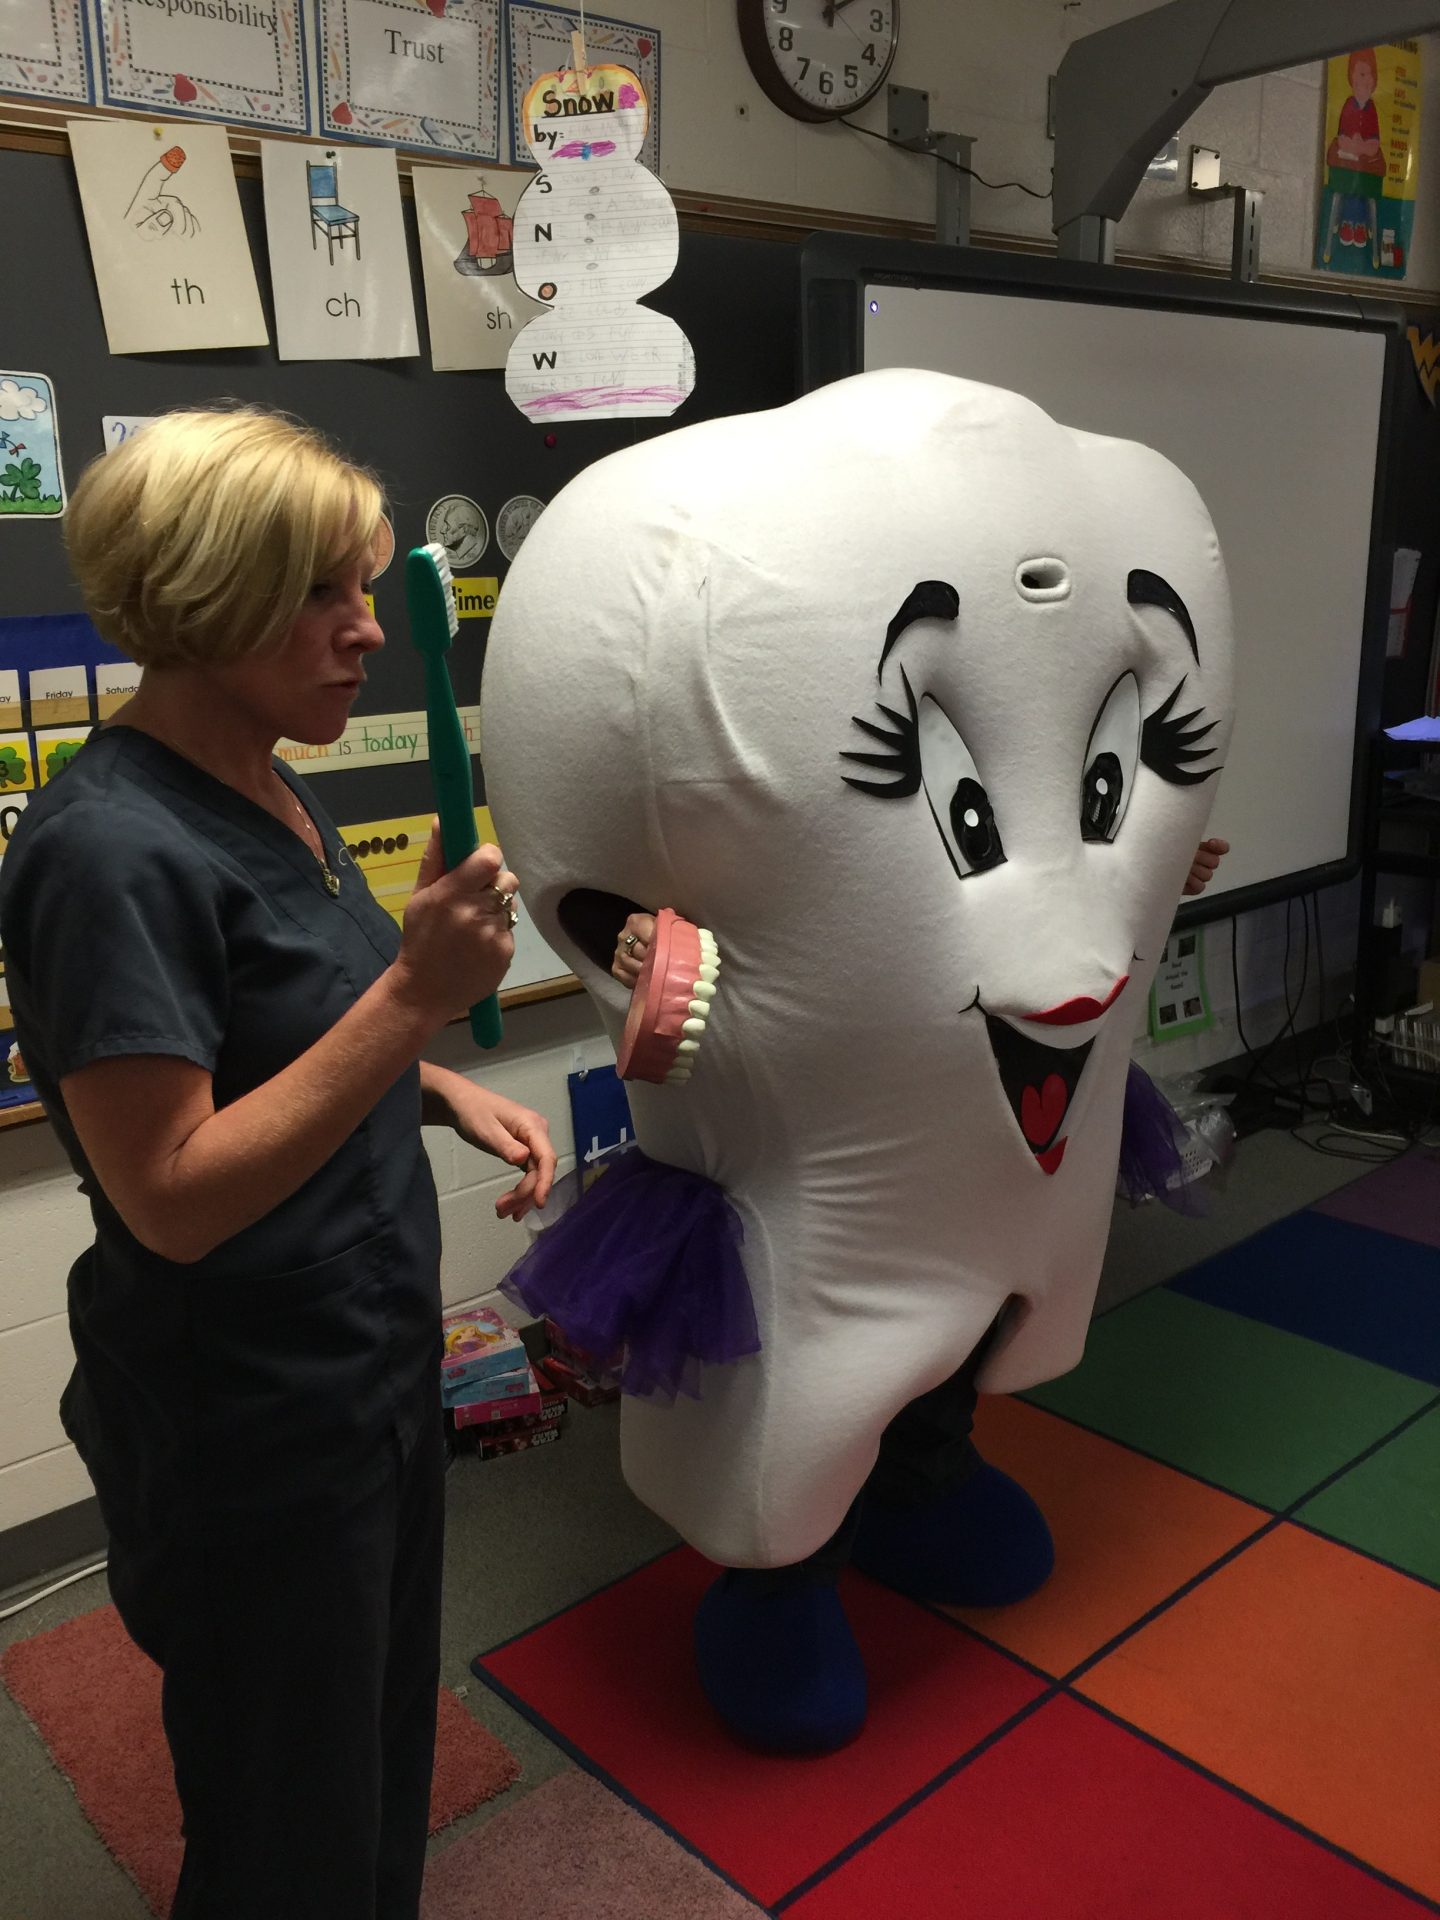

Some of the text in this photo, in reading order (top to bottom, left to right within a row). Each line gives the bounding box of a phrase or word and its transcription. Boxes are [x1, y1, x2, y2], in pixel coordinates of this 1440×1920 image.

[131, 0, 278, 36] sponsibility
[869, 9, 883, 32] 3
[384, 28, 445, 64] Trust
[778, 27, 793, 51] 8
[861, 43, 876, 66] 4
[797, 57, 810, 80] 7
[844, 65, 858, 88] 5
[819, 71, 834, 95] 6
[541, 89, 616, 118] Snow
[535, 174, 553, 194] S
[534, 223, 553, 243] N
[170, 278, 206, 305] th
[538, 282, 558, 301] O
[325, 292, 361, 318] ch
[486, 306, 512, 330] sh
[533, 351, 557, 371] W
[45, 690, 73, 700] Friday
[106, 685, 139, 695] Saturda
[361, 724, 418, 759] today
